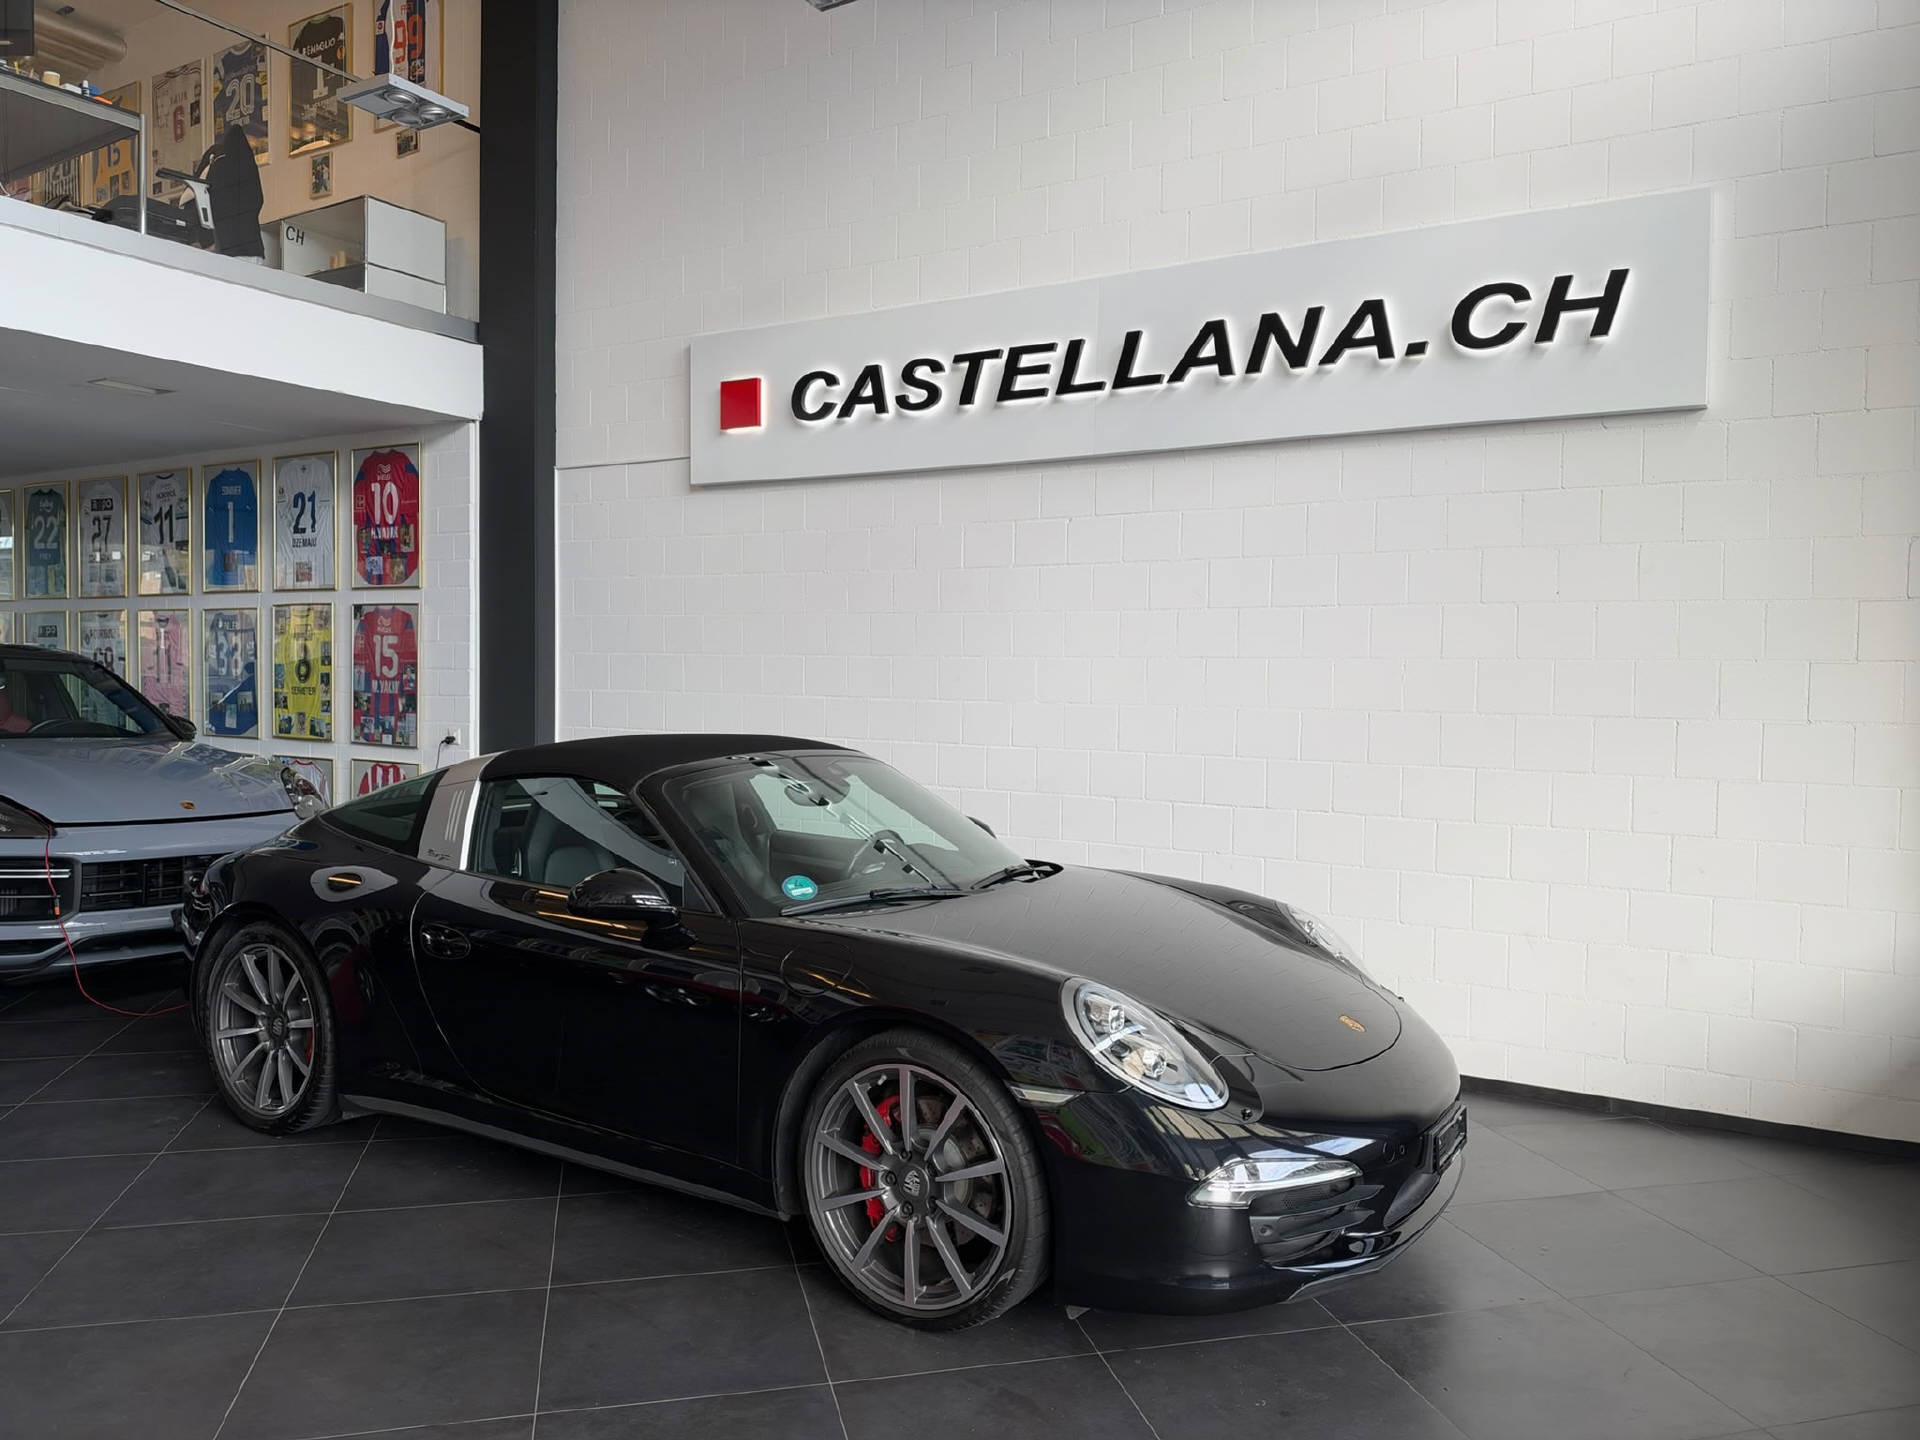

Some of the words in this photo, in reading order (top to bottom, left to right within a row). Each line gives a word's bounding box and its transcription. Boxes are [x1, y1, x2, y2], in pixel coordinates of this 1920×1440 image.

[225, 74, 255, 121] 20
[286, 225, 304, 246] CH
[791, 268, 1631, 424] CASTELLANA.CH
[227, 501, 234, 543] 1
[293, 490, 317, 534] 21
[371, 481, 400, 524] 10
[34, 515, 58, 550] 22
[92, 515, 112, 552] 27
[154, 504, 174, 545] 11
[373, 635, 399, 678] 15
